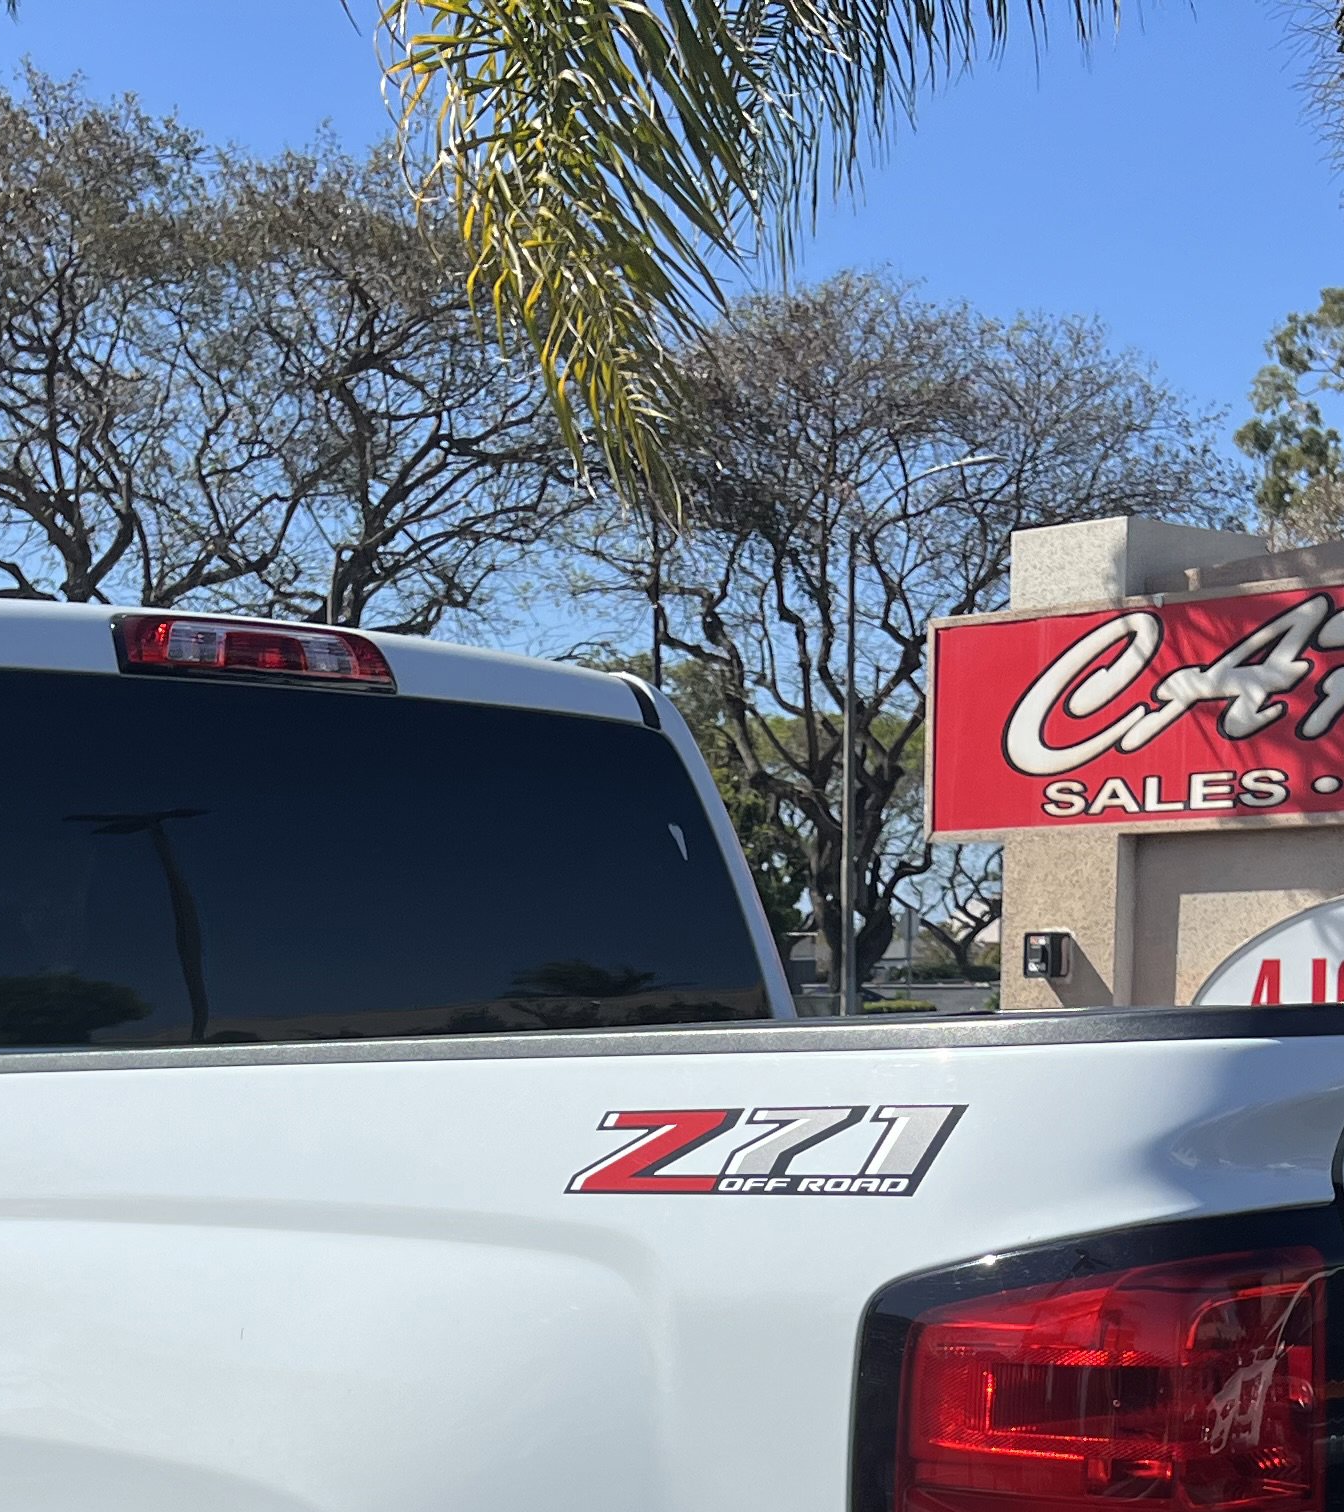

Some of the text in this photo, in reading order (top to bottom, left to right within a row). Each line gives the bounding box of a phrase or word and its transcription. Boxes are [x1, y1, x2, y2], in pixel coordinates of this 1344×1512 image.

[1041, 768, 1289, 820] SALES
[564, 1104, 969, 1197] Z71
[717, 1177, 910, 1193] OFF ROAD
